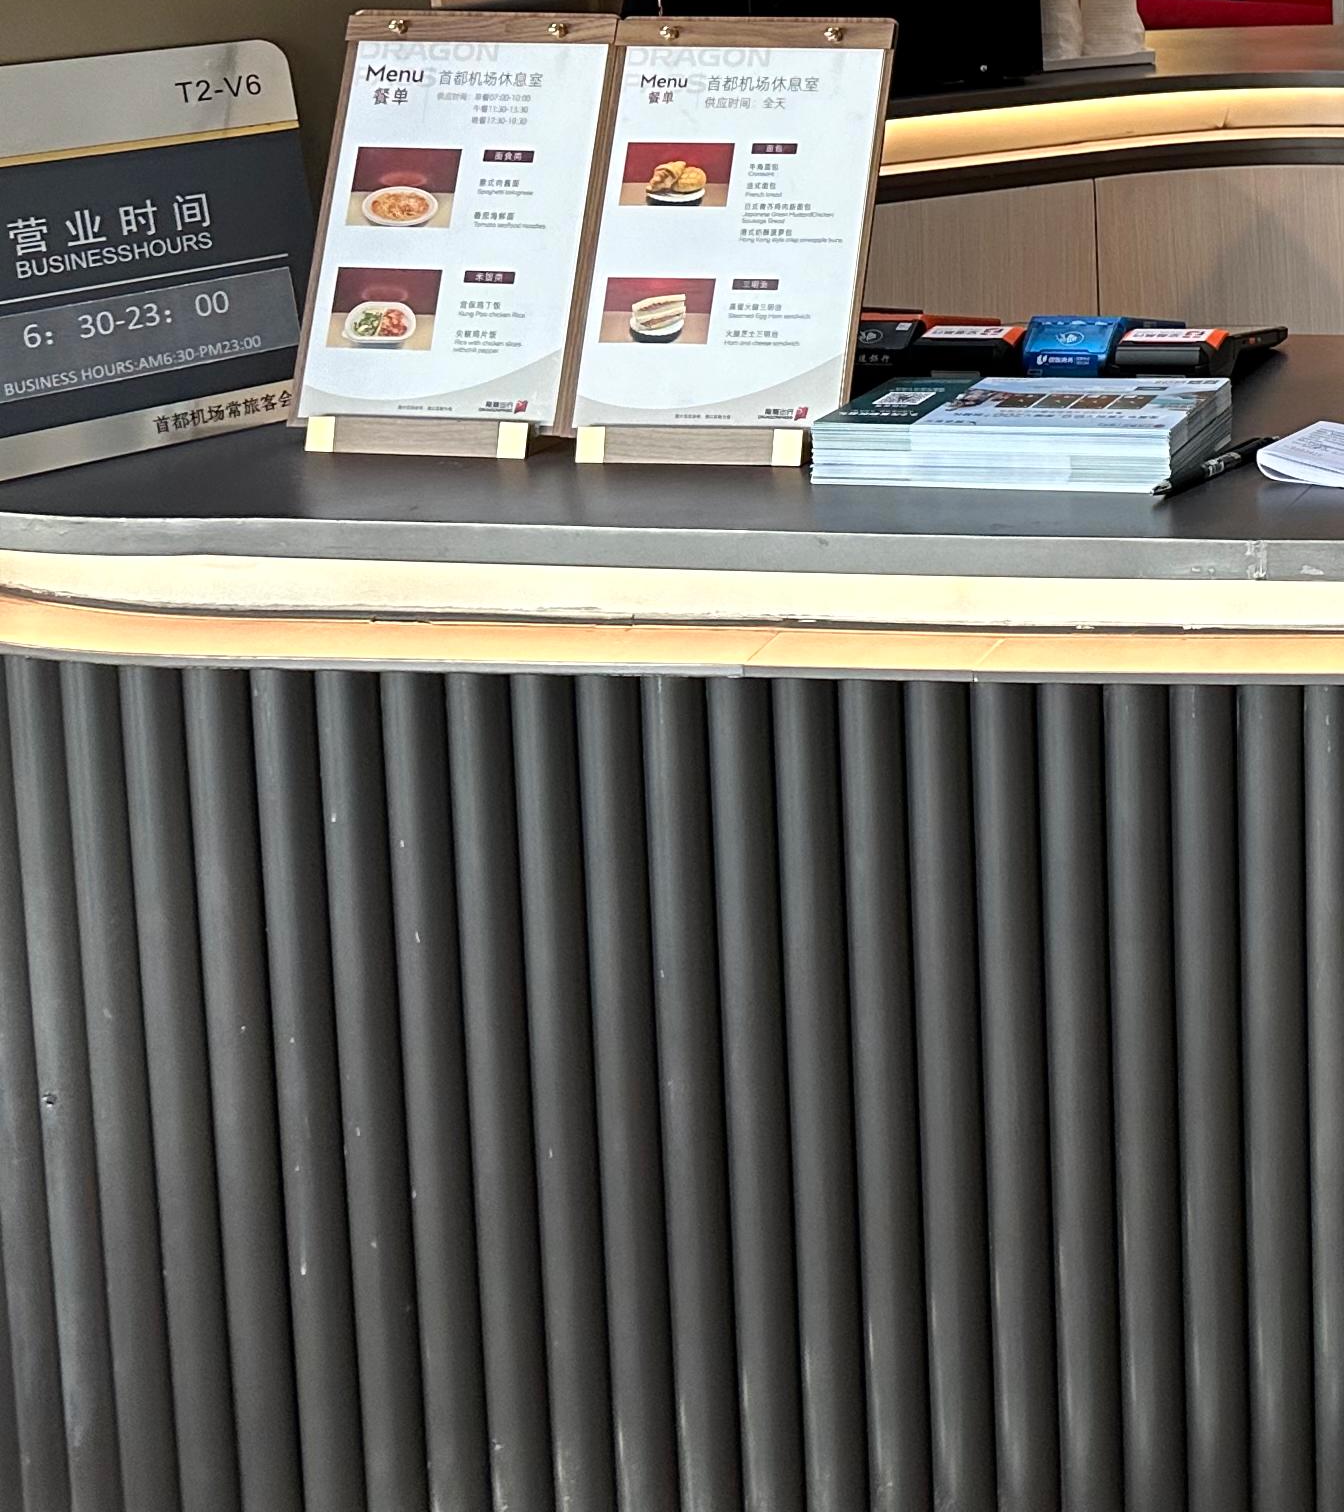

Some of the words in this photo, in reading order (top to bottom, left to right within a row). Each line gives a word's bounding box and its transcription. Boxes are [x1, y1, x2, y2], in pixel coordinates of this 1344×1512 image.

[628, 47, 771, 67] DRAGON
[365, 64, 424, 83] Menu
[439, 70, 543, 88] 首都机场休息室
[641, 74, 688, 88] Menu
[175, 74, 262, 104] T2-V6
[707, 76, 820, 92] 首都机场休息室
[373, 88, 409, 105] 餐单
[648, 91, 674, 104] 餐单
[763, 97, 786, 109] 全天
[8, 193, 212, 256] 营业时间
[3, 370, 78, 397] BUSINESS
